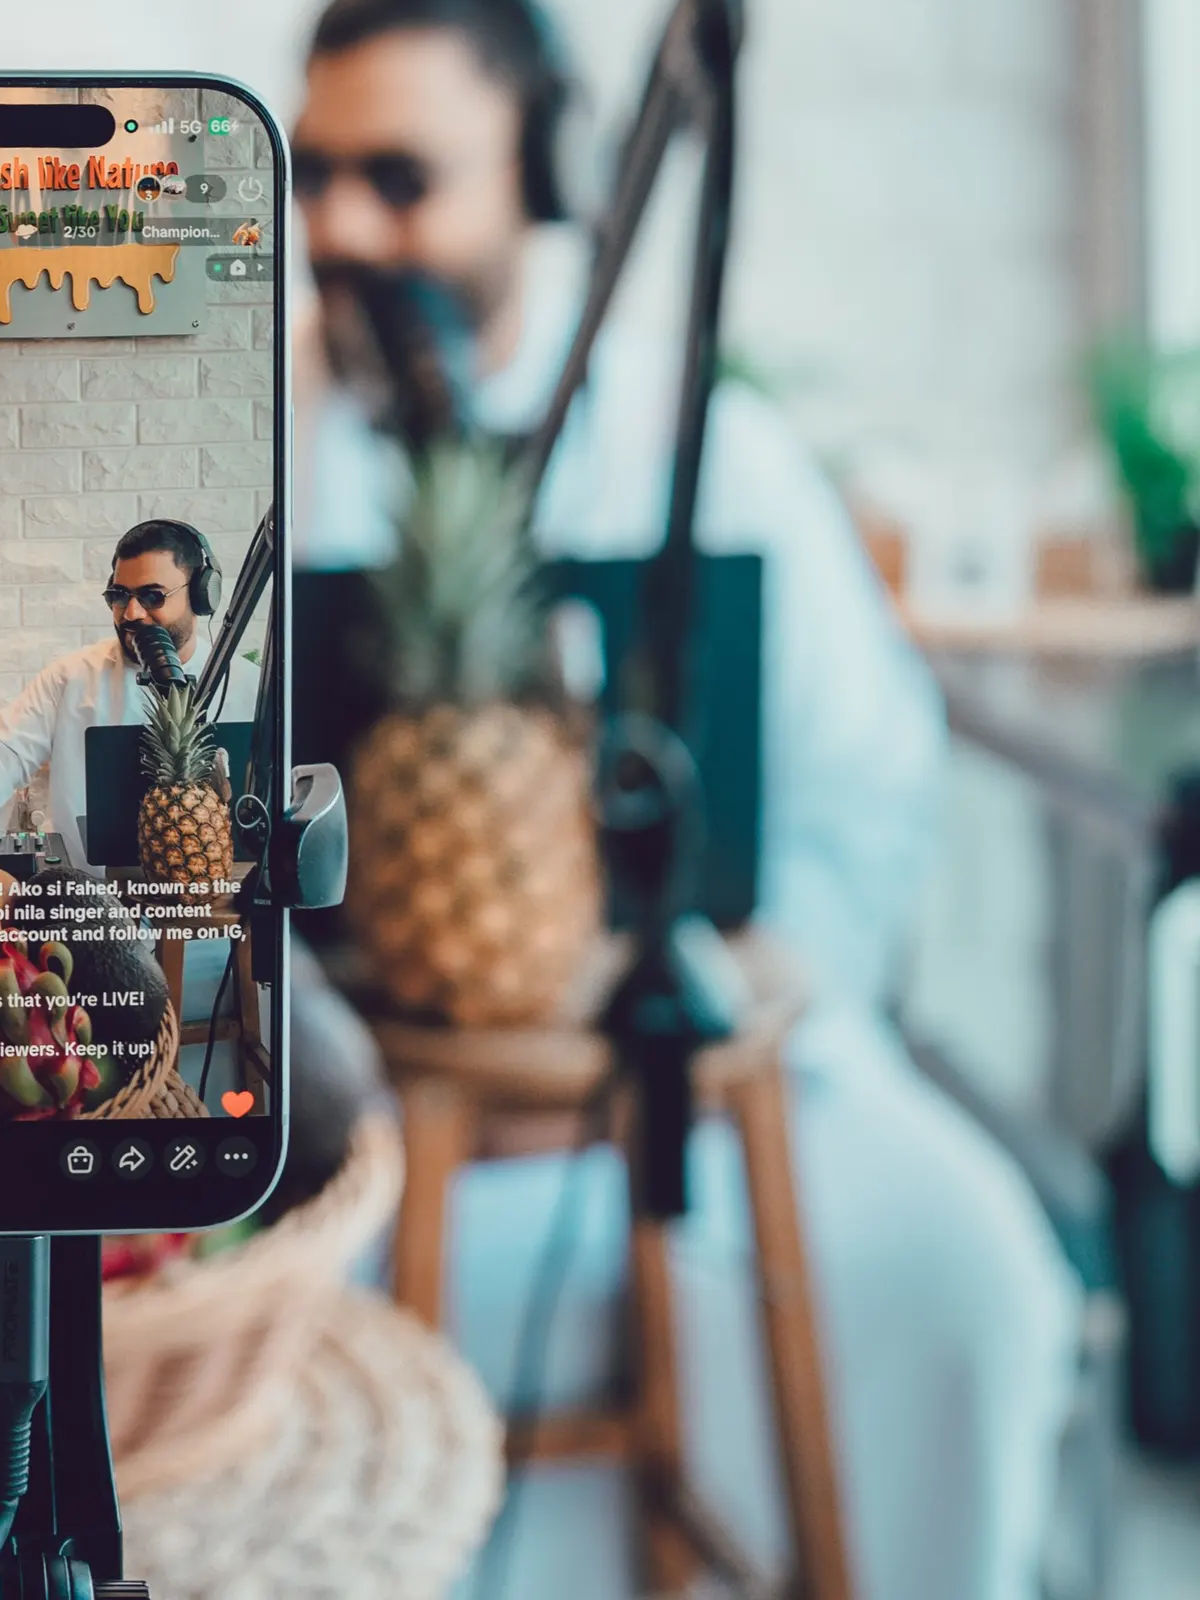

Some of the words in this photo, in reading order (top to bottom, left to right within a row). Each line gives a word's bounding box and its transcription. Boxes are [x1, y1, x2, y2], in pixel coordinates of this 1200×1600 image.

[180, 120, 202, 134] 5G
[210, 120, 231, 133] 66
[37, 155, 81, 191] like
[200, 183, 208, 194] 9
[106, 204, 144, 233] You
[64, 226, 96, 238] 2/30
[142, 225, 220, 240] Champion...
[9, 882, 43, 896] Ako
[47, 880, 62, 896] si
[66, 880, 123, 898] Fahed,
[127, 879, 184, 895] known
[189, 882, 209, 894] as
[213, 877, 242, 893] the
[14, 904, 45, 919] nila
[49, 904, 103, 923] singer
[108, 903, 141, 918] and
[145, 903, 212, 918] content
[72, 926, 104, 941] and
[109, 925, 163, 941] follow
[167, 928, 193, 939] me
[197, 926, 219, 939] on
[224, 925, 247, 942] IG,
[7, 992, 42, 1008] that
[45, 992, 98, 1010] you’re
[102, 991, 145, 1006] LIVE!
[65, 1041, 108, 1059] Keep
[112, 1040, 125, 1055] it
[128, 1040, 156, 1058] up!
